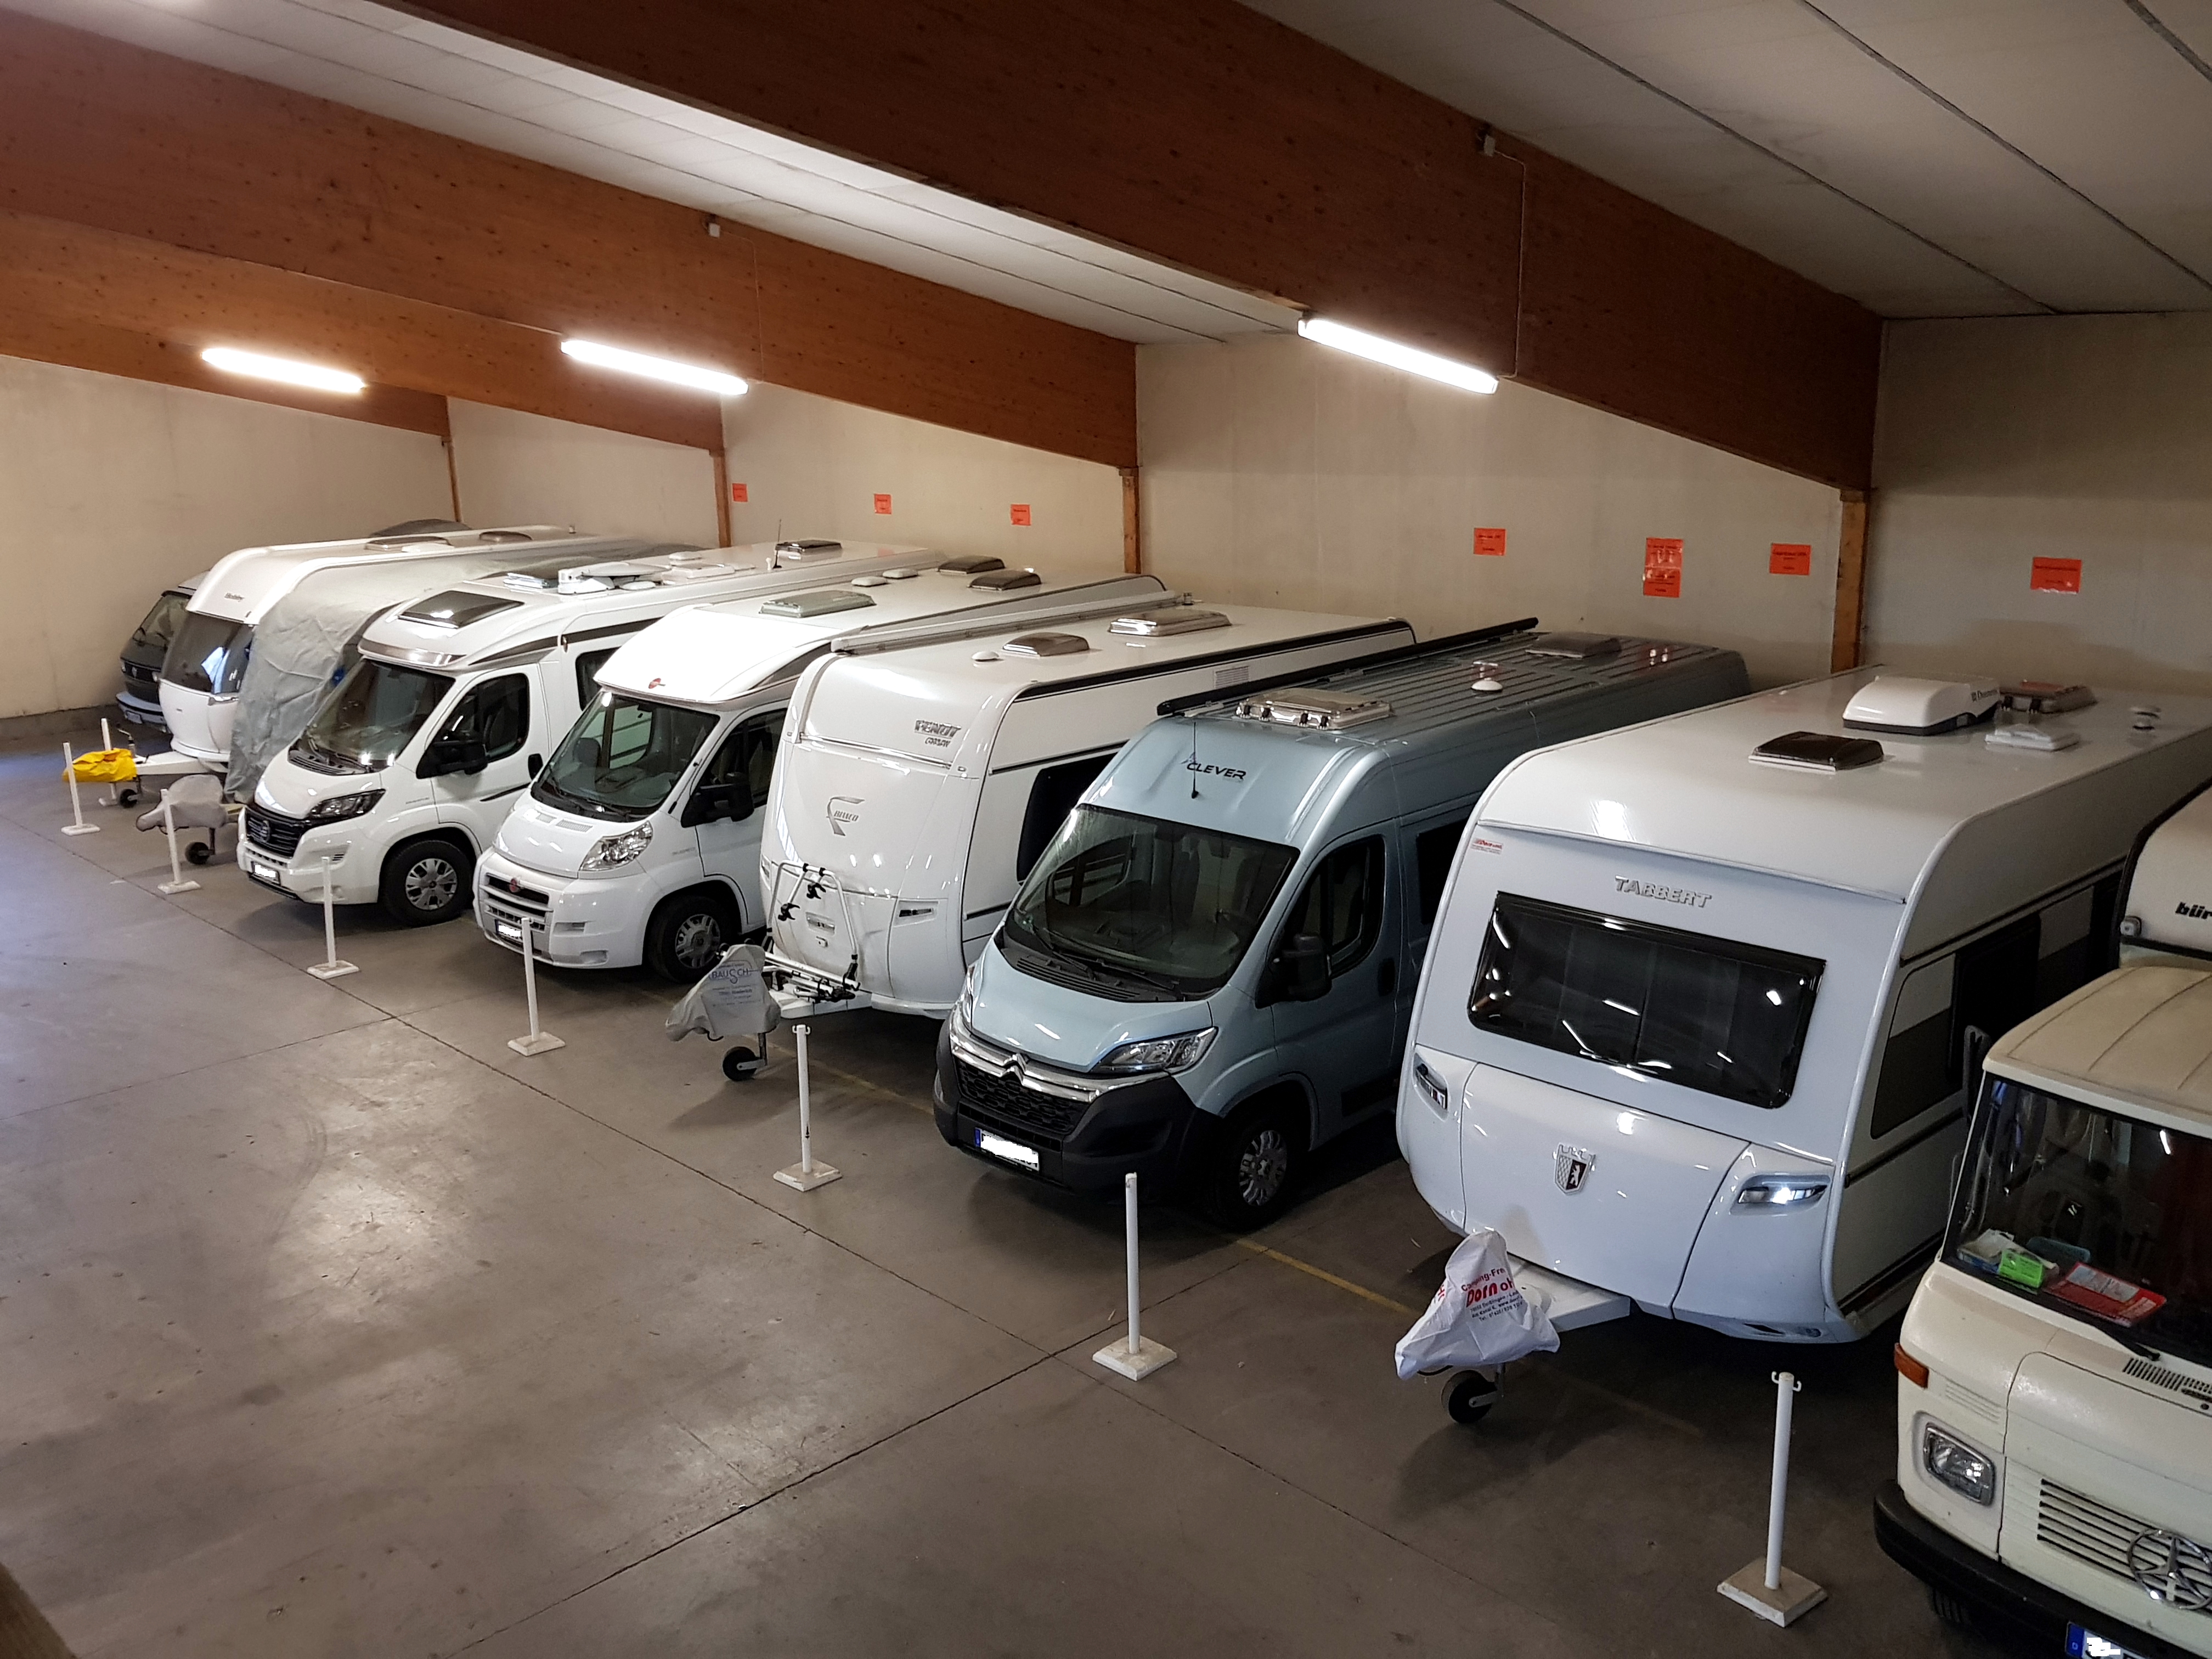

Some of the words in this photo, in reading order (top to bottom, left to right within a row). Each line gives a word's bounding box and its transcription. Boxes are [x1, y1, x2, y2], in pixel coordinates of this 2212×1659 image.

[1187, 762, 1246, 780] CLEVER
[1615, 875, 1712, 908] TABBERT
[712, 968, 749, 984] BAUSCH
[1466, 1283, 1498, 1308] Dorn
